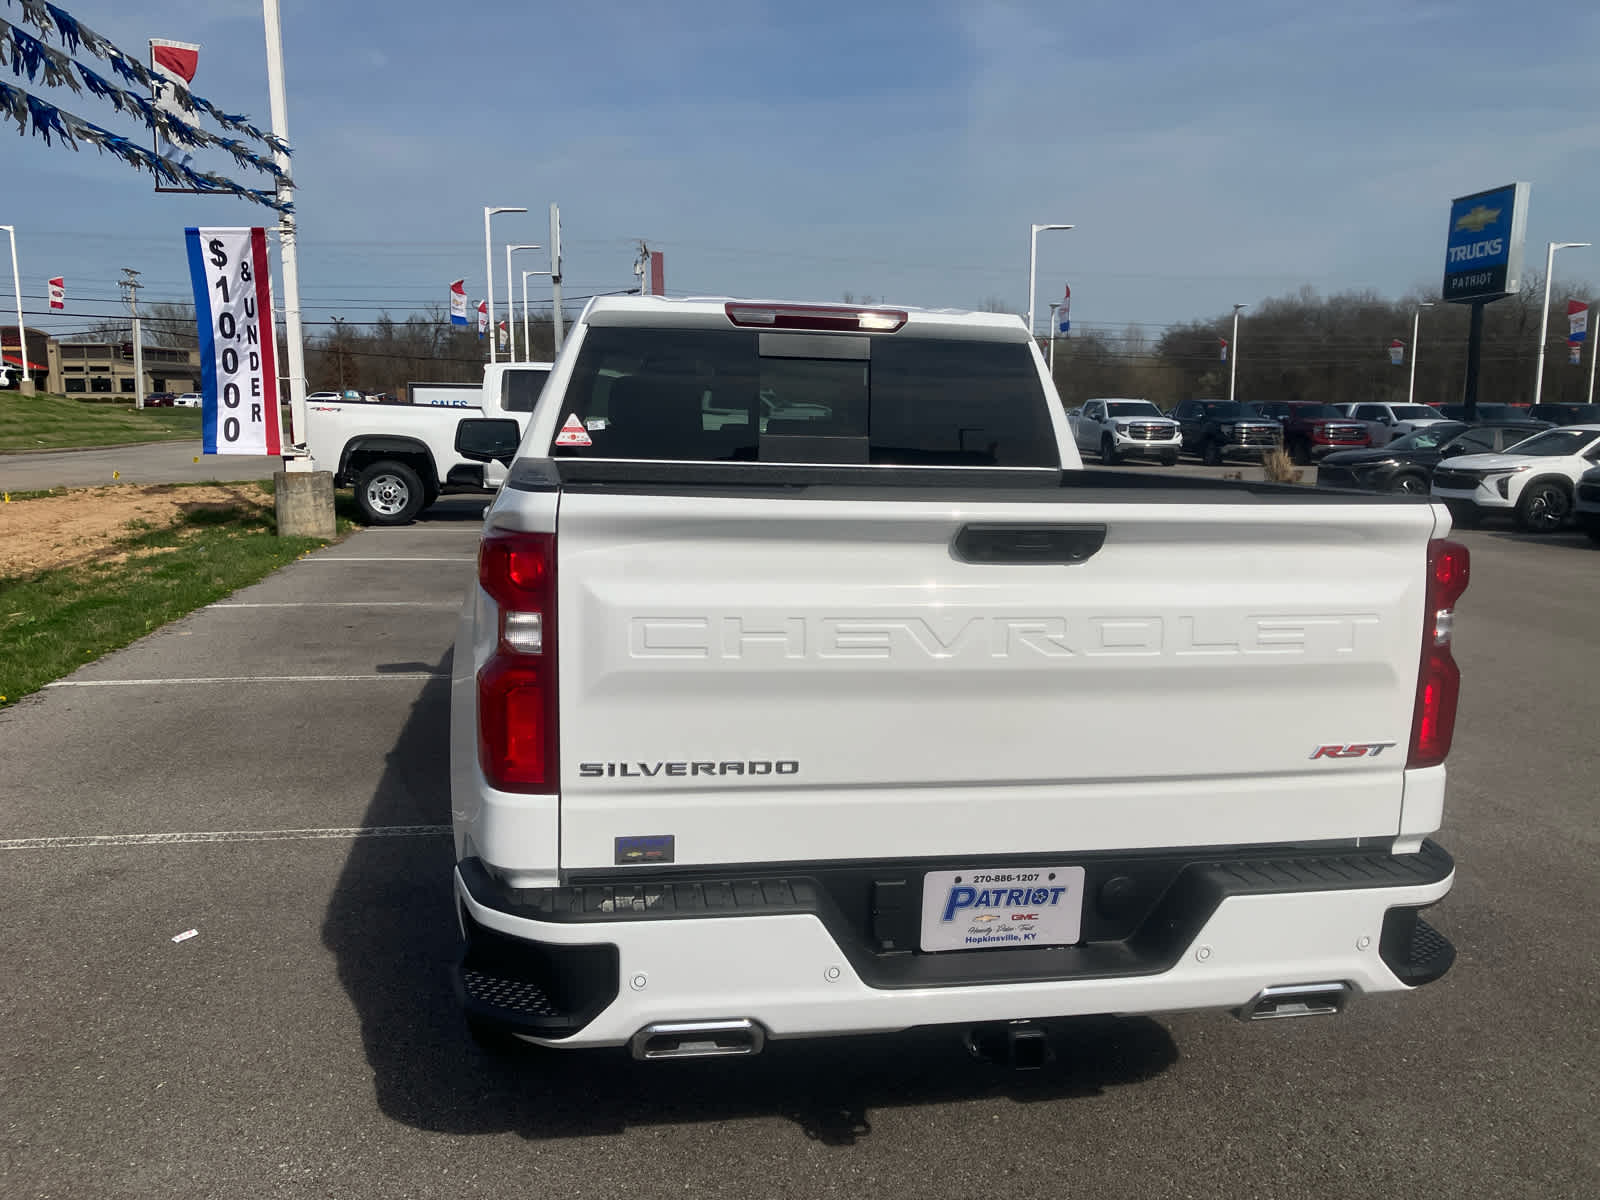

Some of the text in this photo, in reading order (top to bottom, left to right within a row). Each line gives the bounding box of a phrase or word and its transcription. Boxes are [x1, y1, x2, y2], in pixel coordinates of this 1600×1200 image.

[1450, 238, 1503, 262] TRUCKS
[1452, 272, 1493, 288] PATRIOT
[209, 238, 240, 442] $10,000
[240, 261, 262, 423] & UNDER
[628, 613, 1380, 657] CHEVROLET
[1308, 743, 1397, 760] RST
[579, 760, 799, 777] SILVERADO
[973, 874, 1040, 883] 270-886-1207
[943, 886, 1066, 921] PATRIOT
[1011, 913, 1040, 921] GMC
[965, 934, 1021, 944] Hopkinsville,
